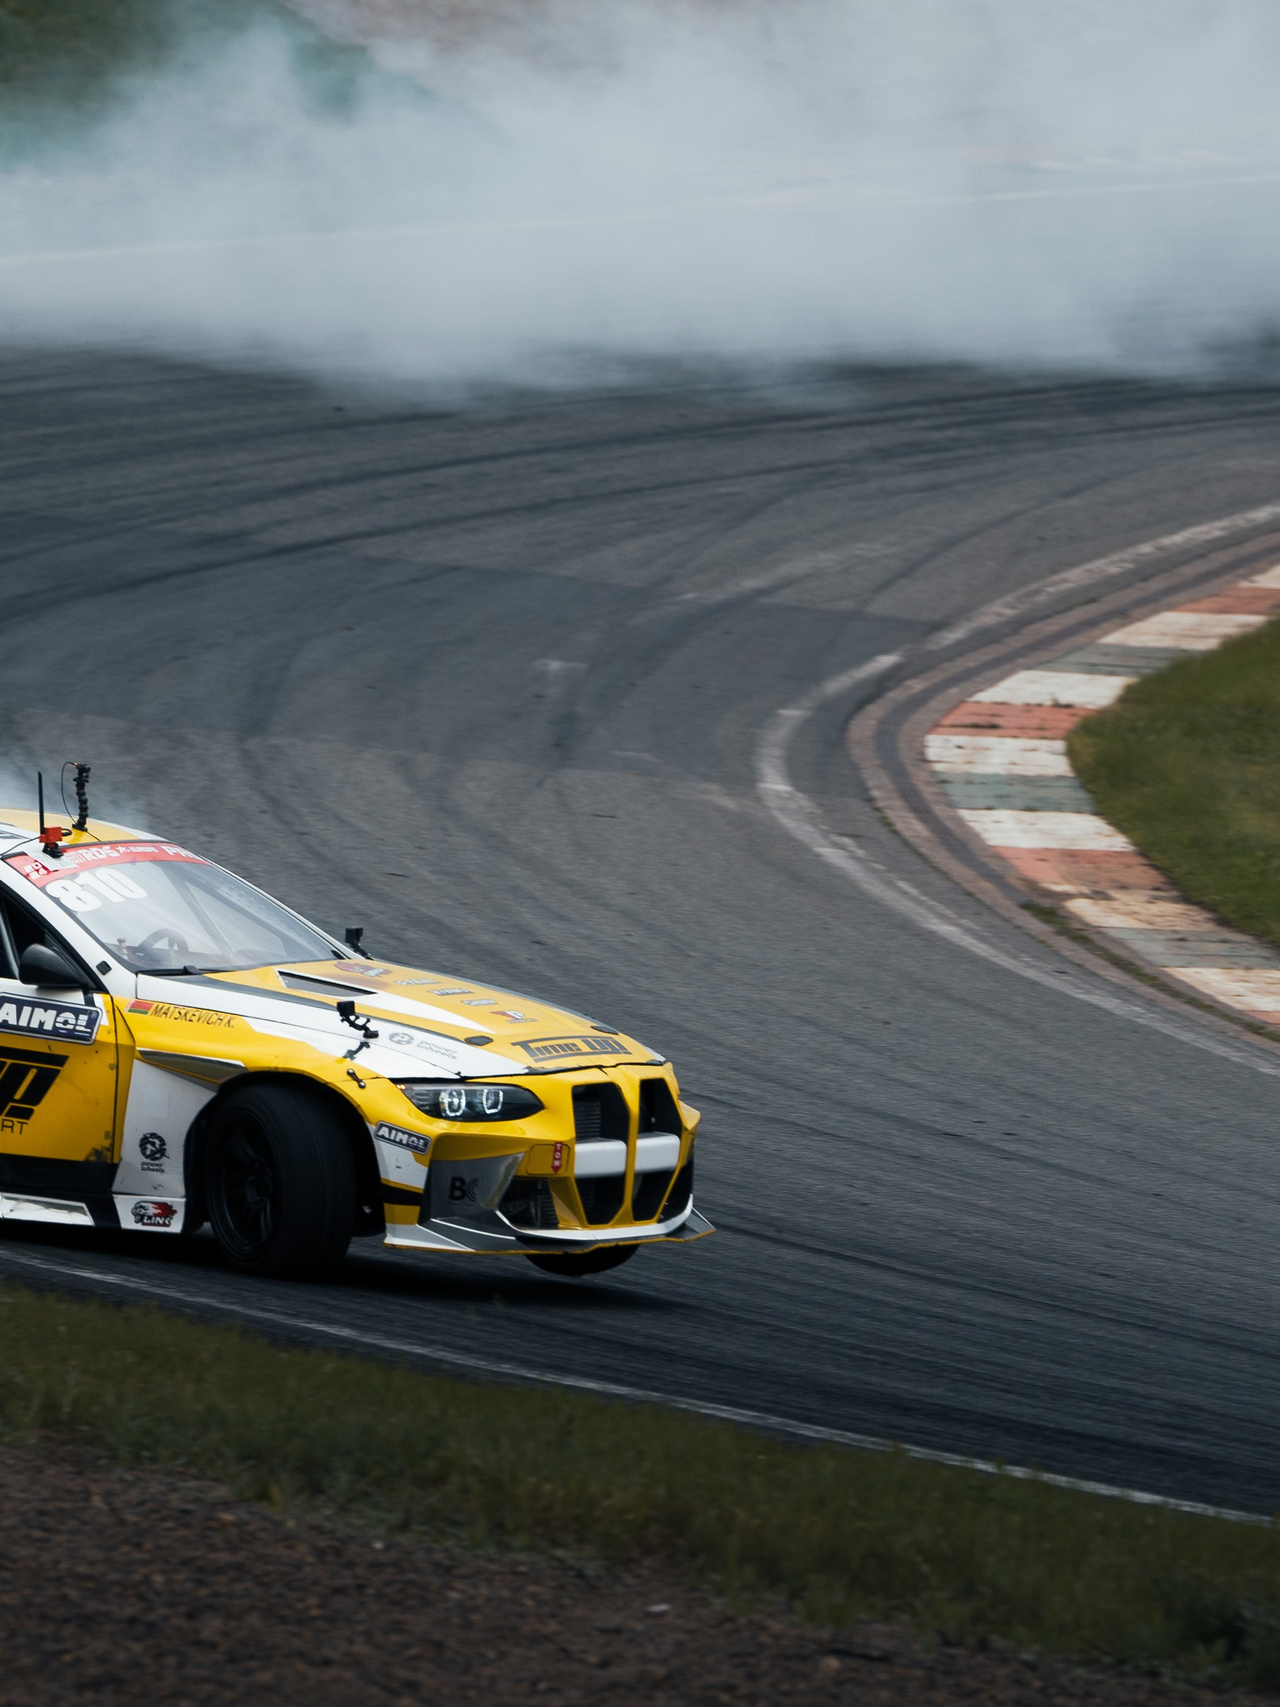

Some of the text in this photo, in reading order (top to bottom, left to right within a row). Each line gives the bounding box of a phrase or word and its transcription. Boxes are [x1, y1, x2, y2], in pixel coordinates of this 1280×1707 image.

[45, 869, 147, 912] 810
[150, 1003, 224, 1026] MATSKEVICH
[553, 1143, 562, 1167] TOW
